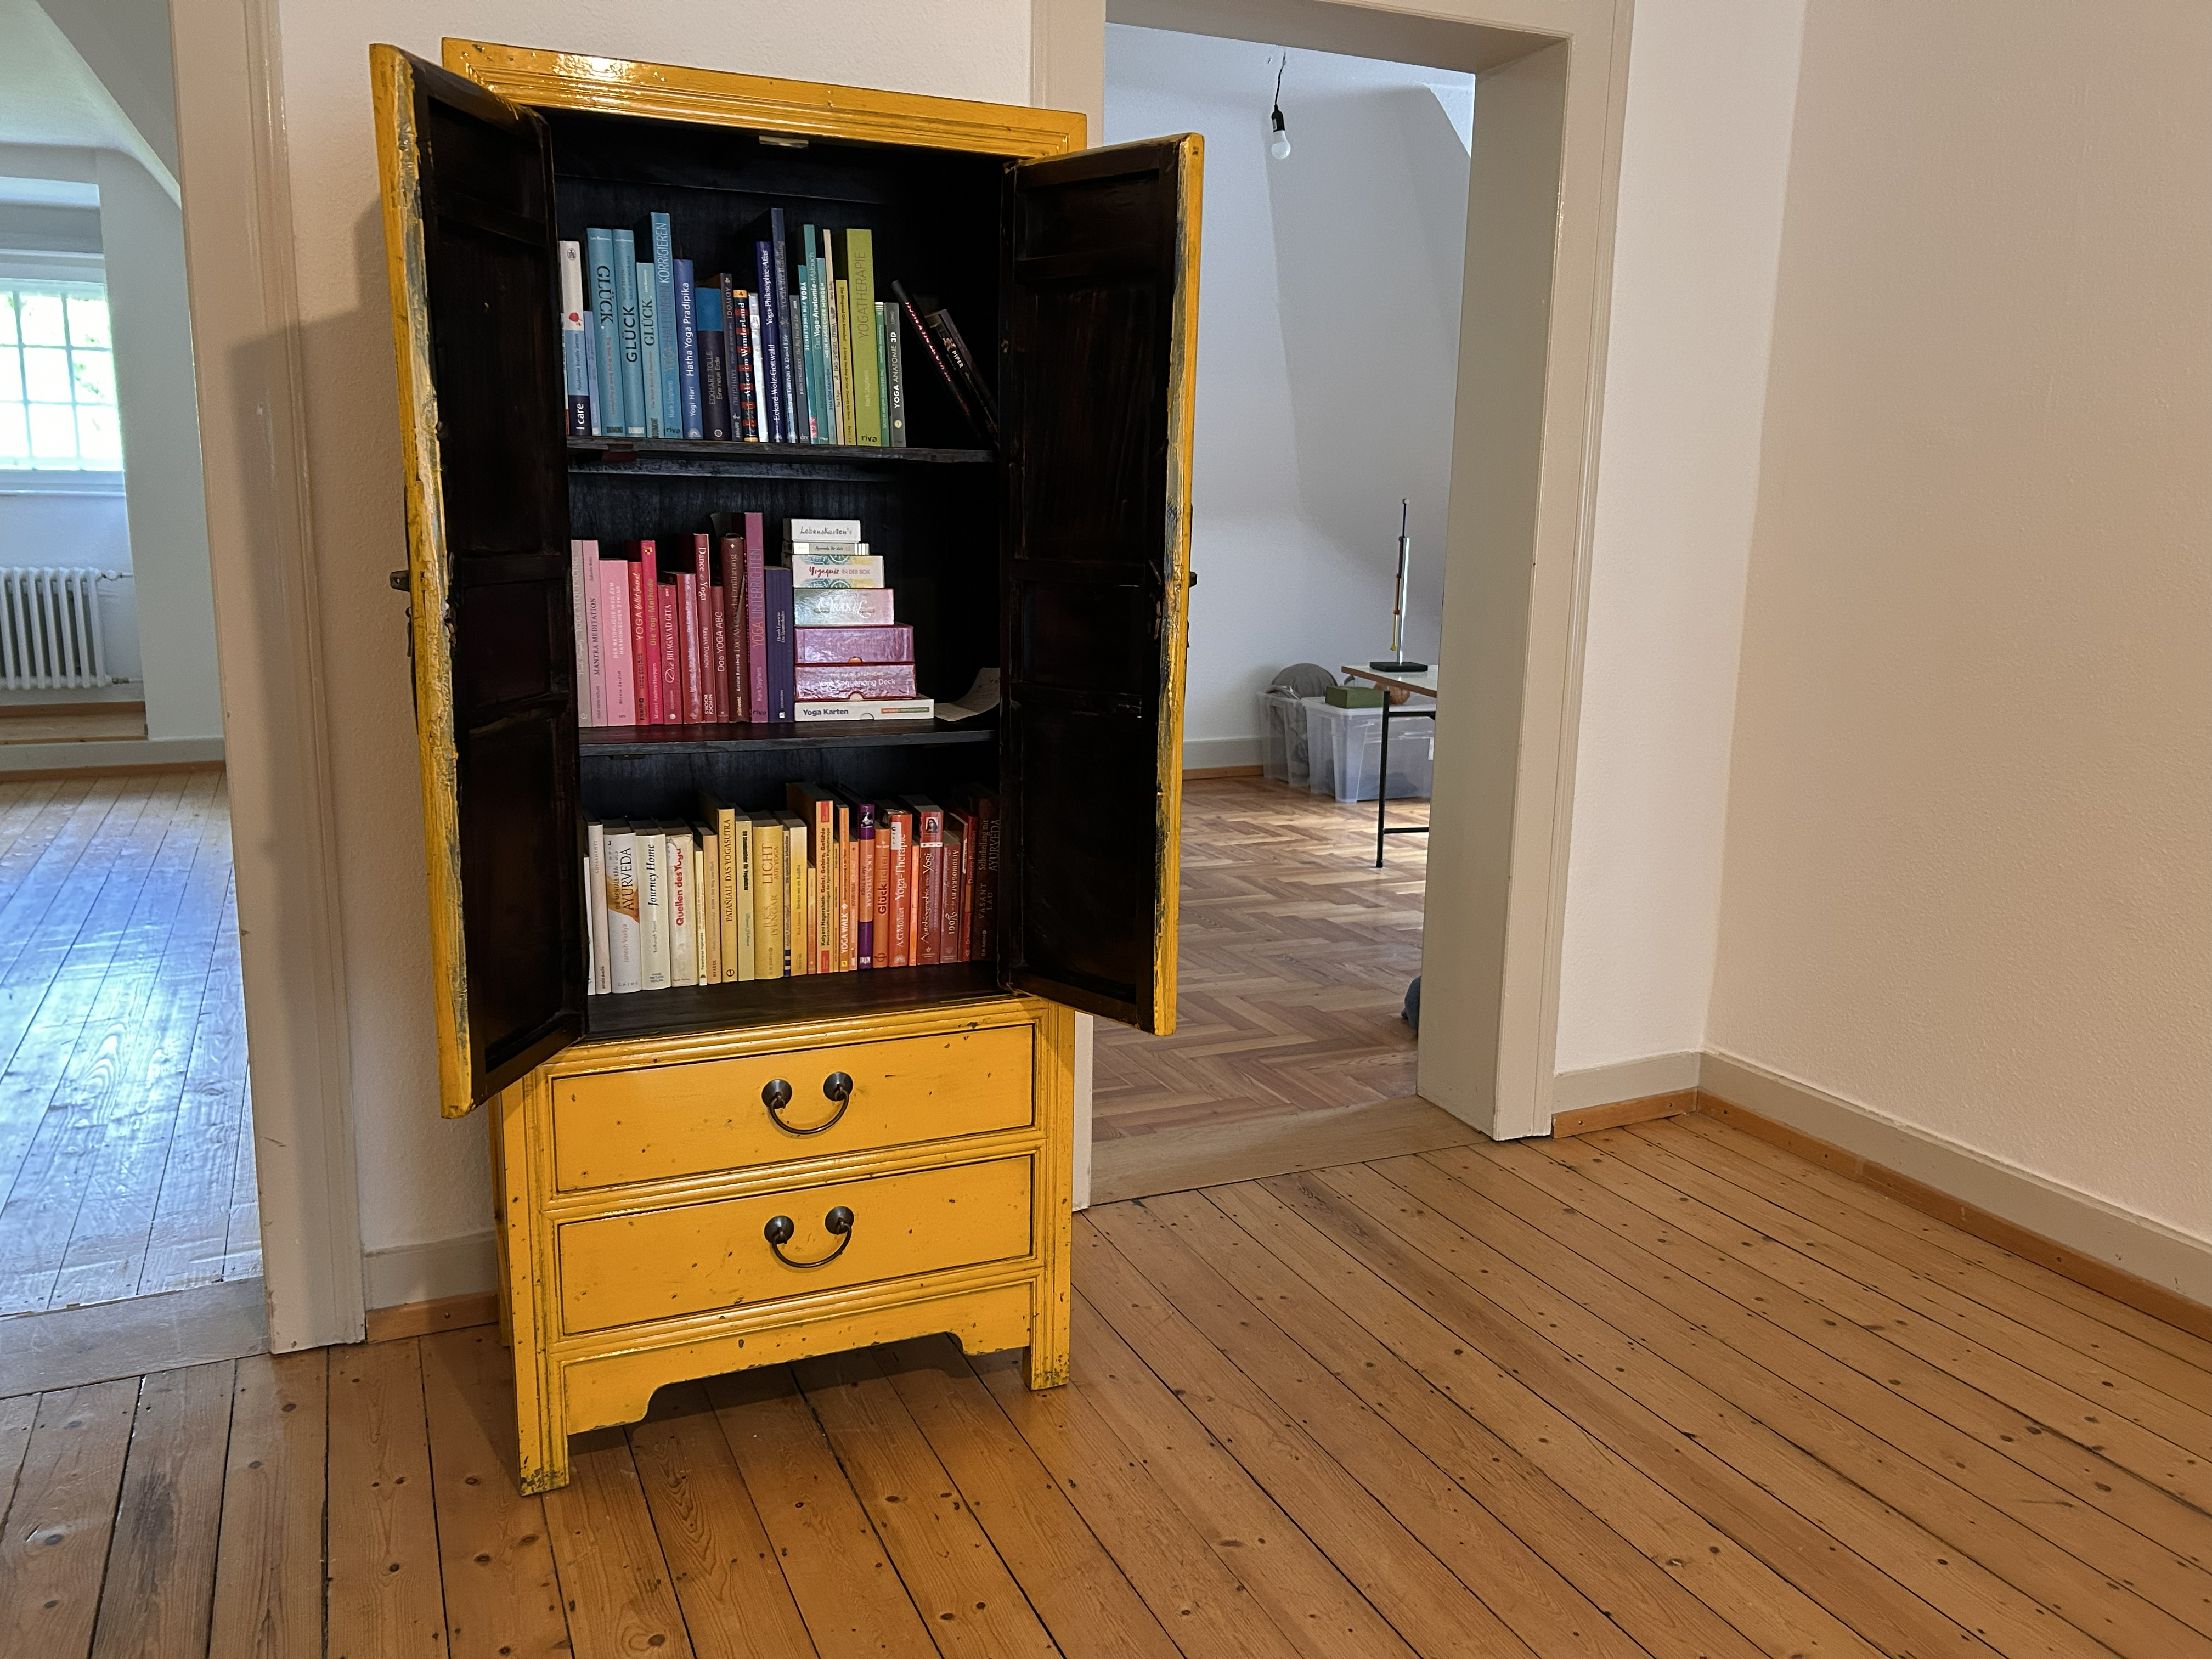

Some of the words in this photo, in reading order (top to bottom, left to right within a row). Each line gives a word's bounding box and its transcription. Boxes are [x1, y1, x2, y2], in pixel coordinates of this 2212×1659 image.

[656, 223, 670, 284] KORRIGIEREN
[761, 250, 774, 325] Yoga-Philosophie-Atlas
[778, 286, 787, 308] YOGA
[854, 251, 870, 338] YOGATHERAPIE
[681, 282, 692, 325] Pradipika
[621, 306, 637, 363] GLÜCK
[685, 326, 694, 348] Yoga
[738, 303, 749, 357] Wunderland
[890, 332, 897, 343] 3D
[686, 350, 695, 376] Hatha
[706, 351, 714, 372] TOLLE
[742, 358, 750, 370] im
[768, 343, 778, 396] Wolz-Gottwald
[891, 345, 899, 383] ANATOMIE
[951, 350, 964, 369] PIPER
[708, 374, 716, 405] ECKHART
[741, 373, 752, 397] Alice
[577, 403, 586, 424] care
[772, 396, 781, 420] Eckard
[861, 434, 877, 442] riva
[698, 546, 707, 572] Dance
[809, 566, 839, 578] Yogaquiz
[698, 582, 708, 601] Yoga
[749, 549, 764, 619] UNTERRICHTEN
[590, 597, 599, 643] MEDITATION
[635, 612, 644, 641] YOGA
[664, 604, 673, 621] GITA
[665, 622, 674, 661] BHAGAVAD
[716, 630, 724, 654] YOGA
[752, 621, 764, 647] YOGA
[646, 844, 656, 871] Home
[723, 819, 732, 865] YOGASUTRA
[988, 819, 1001, 872] AYURVEDA
[761, 843, 774, 885] LICHT
[922, 853, 934, 874] Yogi
[619, 848, 634, 911] AYURVEDA
[647, 873, 659, 906] Journey
[674, 872, 683, 888] des
[877, 855, 888, 915] Glücklicher
[675, 890, 684, 926] Quellen
[724, 885, 733, 922] PATAÑJALI
[920, 888, 931, 944] Autobiographie
[979, 882, 987, 919] VASANT
